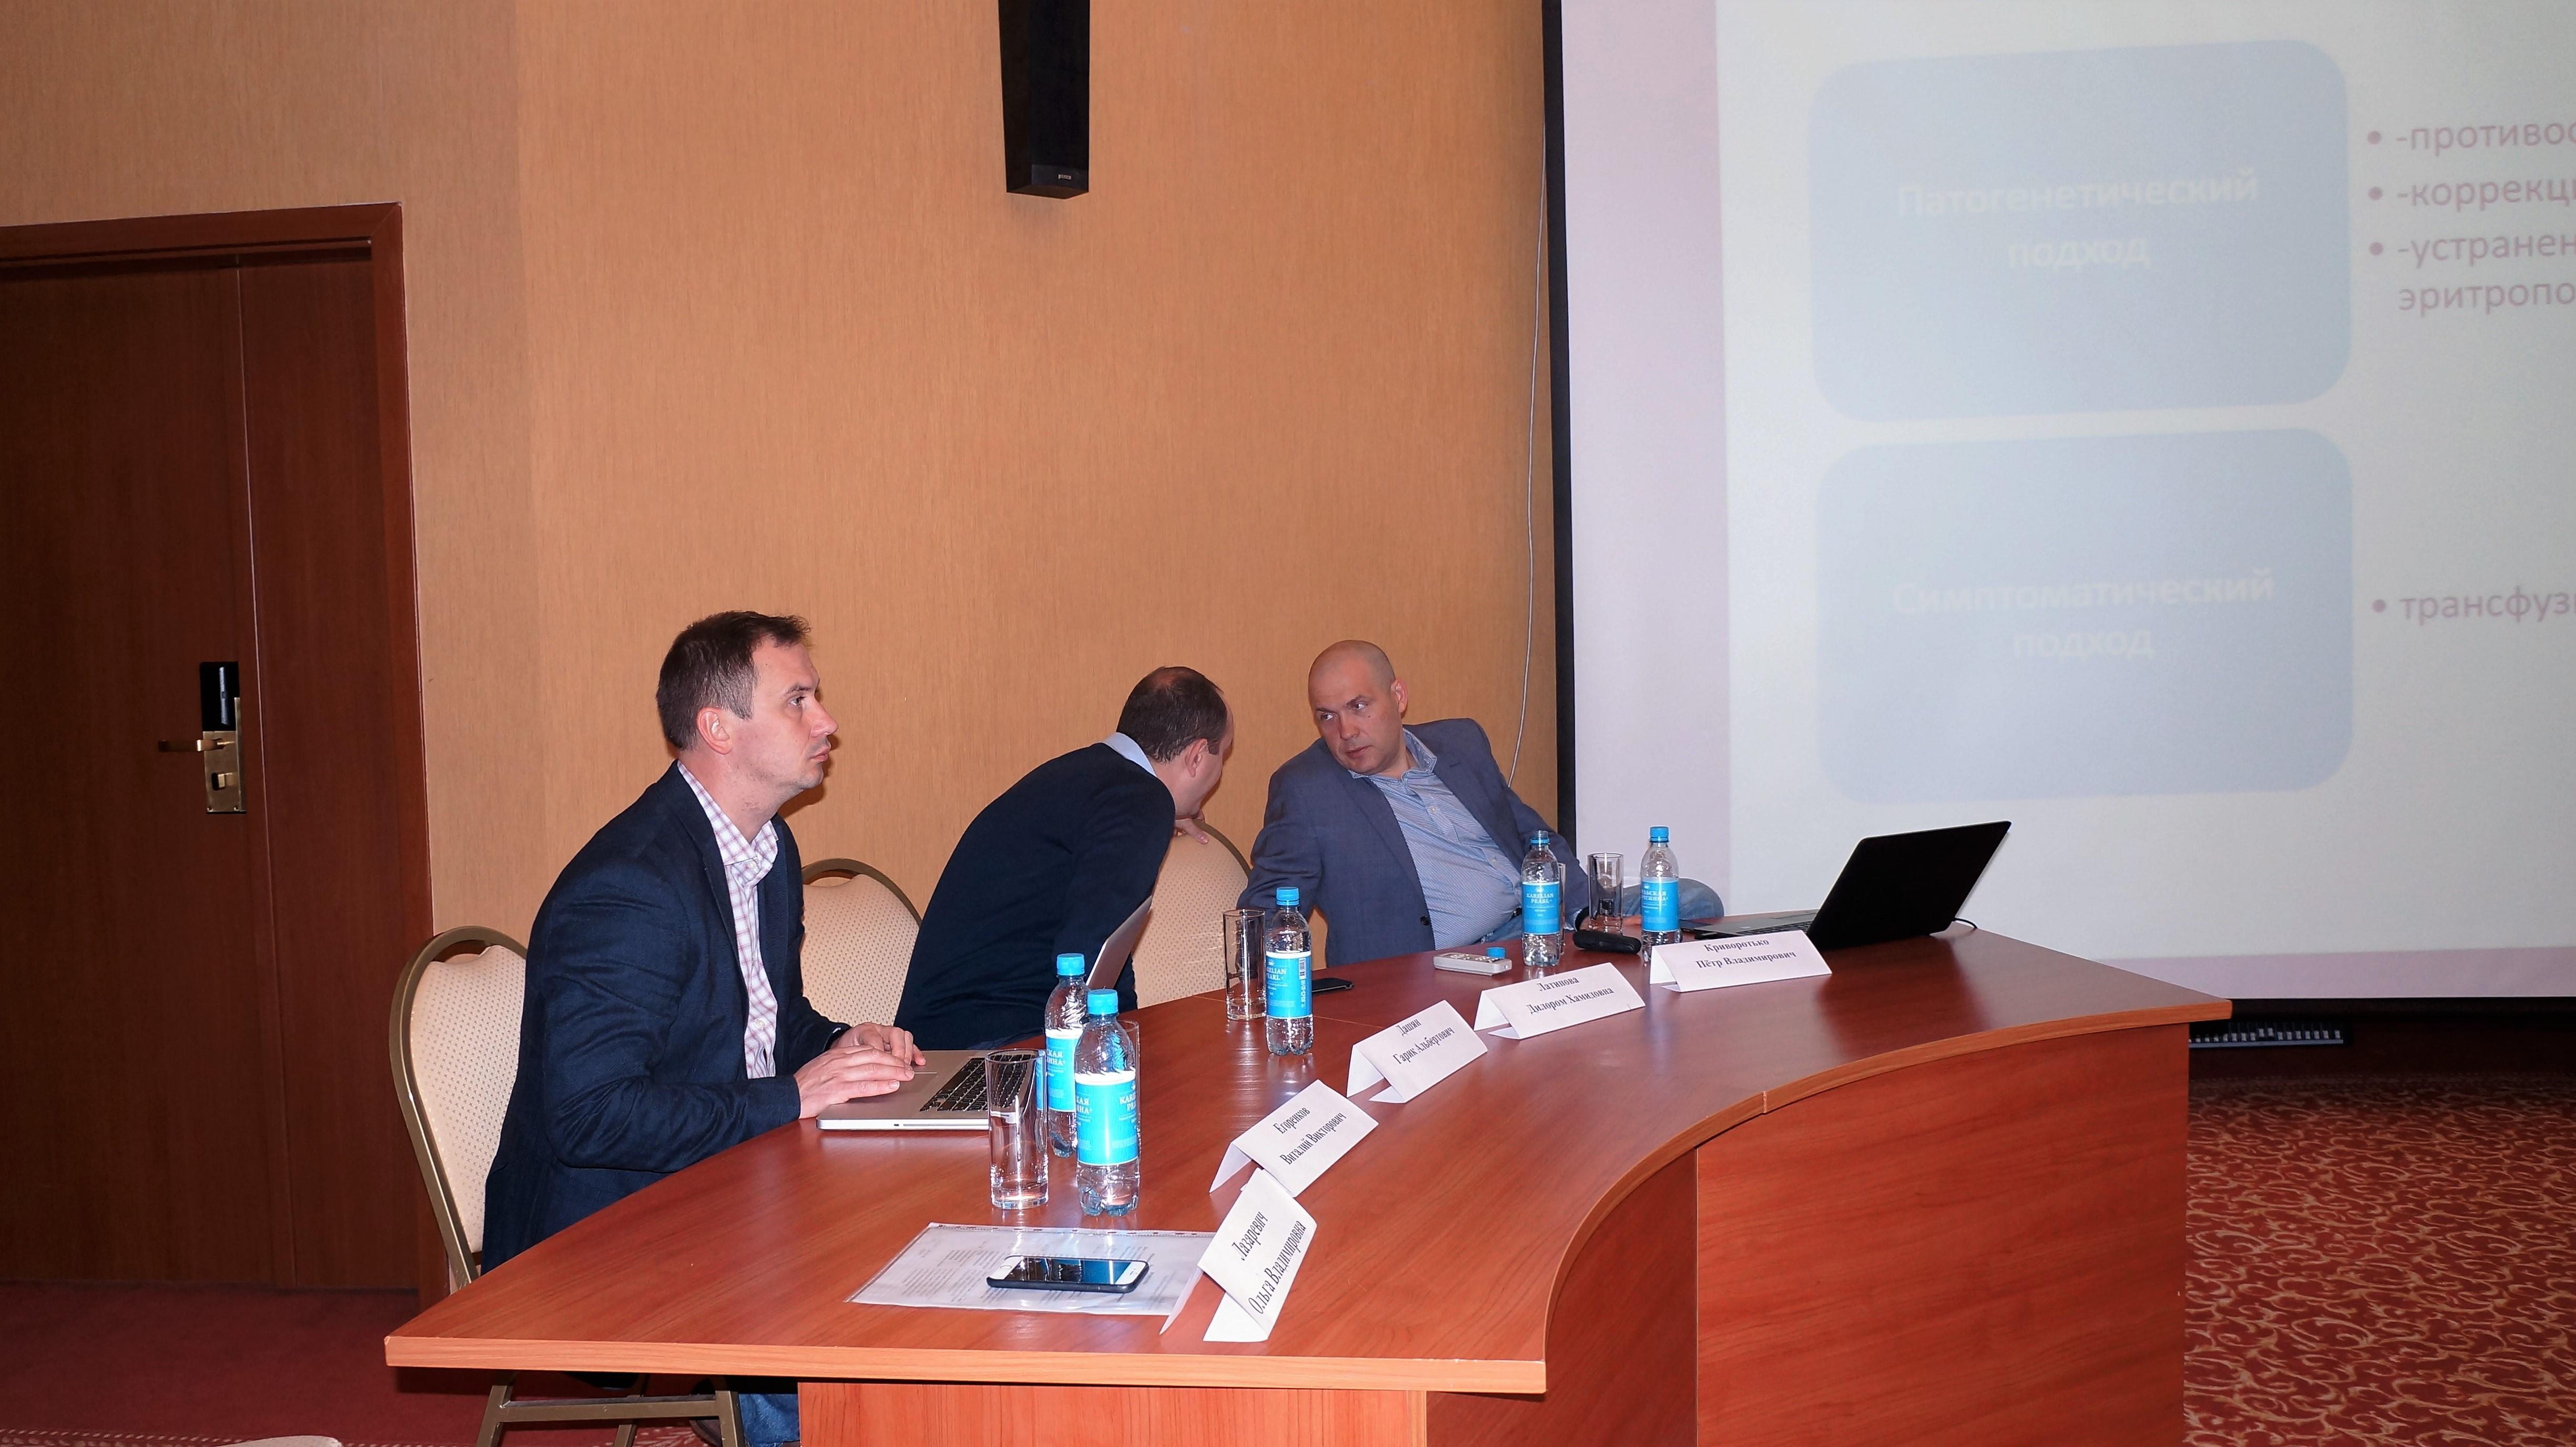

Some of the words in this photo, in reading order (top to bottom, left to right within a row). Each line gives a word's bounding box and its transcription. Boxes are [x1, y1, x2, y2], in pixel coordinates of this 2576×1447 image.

[1898, 167, 2259, 217] Патогенетический
[2397, 178, 2576, 212] -коррекц
[2008, 237, 2150, 272] подход
[2398, 282, 2576, 317] эритропо
[1894, 567, 2275, 615] Симптоматический
[2399, 584, 2576, 626] трансфуз
[2013, 629, 2154, 664] подход
[1696, 958, 1722, 969] Пётр
[1723, 950, 1797, 965] Владимирович
[1703, 939, 1769, 953] Криворотько
[1526, 997, 1567, 1014] Дилором
[1566, 987, 1614, 1004] Хамидовна
[1536, 976, 1579, 991] Латипова
[1393, 1048, 1418, 1064] Гарик
[1415, 1027, 1455, 1052] Альбертович
[1395, 1019, 1421, 1037] Дашян
[1273, 1107, 1311, 1134] Егоренков
[1279, 1137, 1313, 1165] Виталий
[1306, 1112, 1347, 1143] Викторович
[1232, 1211, 1268, 1261] Лазаревич
[1248, 1280, 1276, 1315] Ольга
[1264, 1220, 1307, 1285] Владимировна
